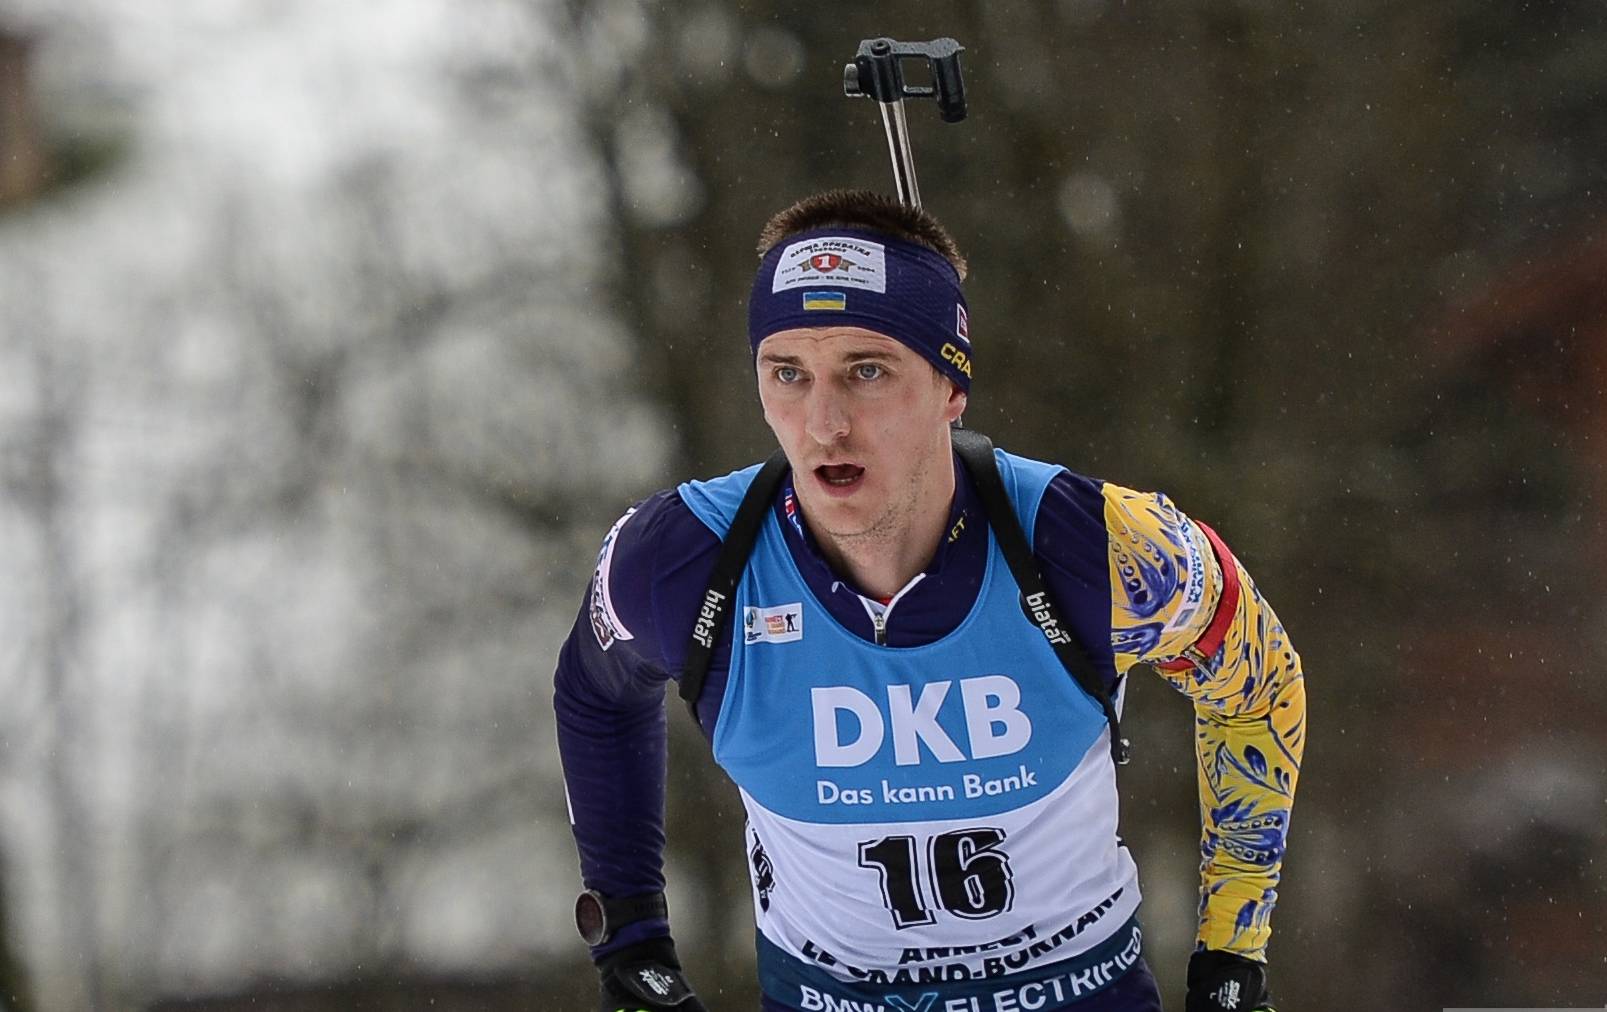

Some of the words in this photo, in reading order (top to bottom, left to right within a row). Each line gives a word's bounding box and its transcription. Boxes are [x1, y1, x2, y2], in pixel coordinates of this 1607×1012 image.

[818, 255, 831, 269] 1
[1026, 591, 1067, 644] biatar
[810, 674, 1032, 767] DKB
[816, 780, 873, 805] Das
[881, 779, 954, 804] kann
[962, 764, 1038, 799] Bank
[857, 827, 1014, 930] 16
[800, 984, 885, 1012] BMW
